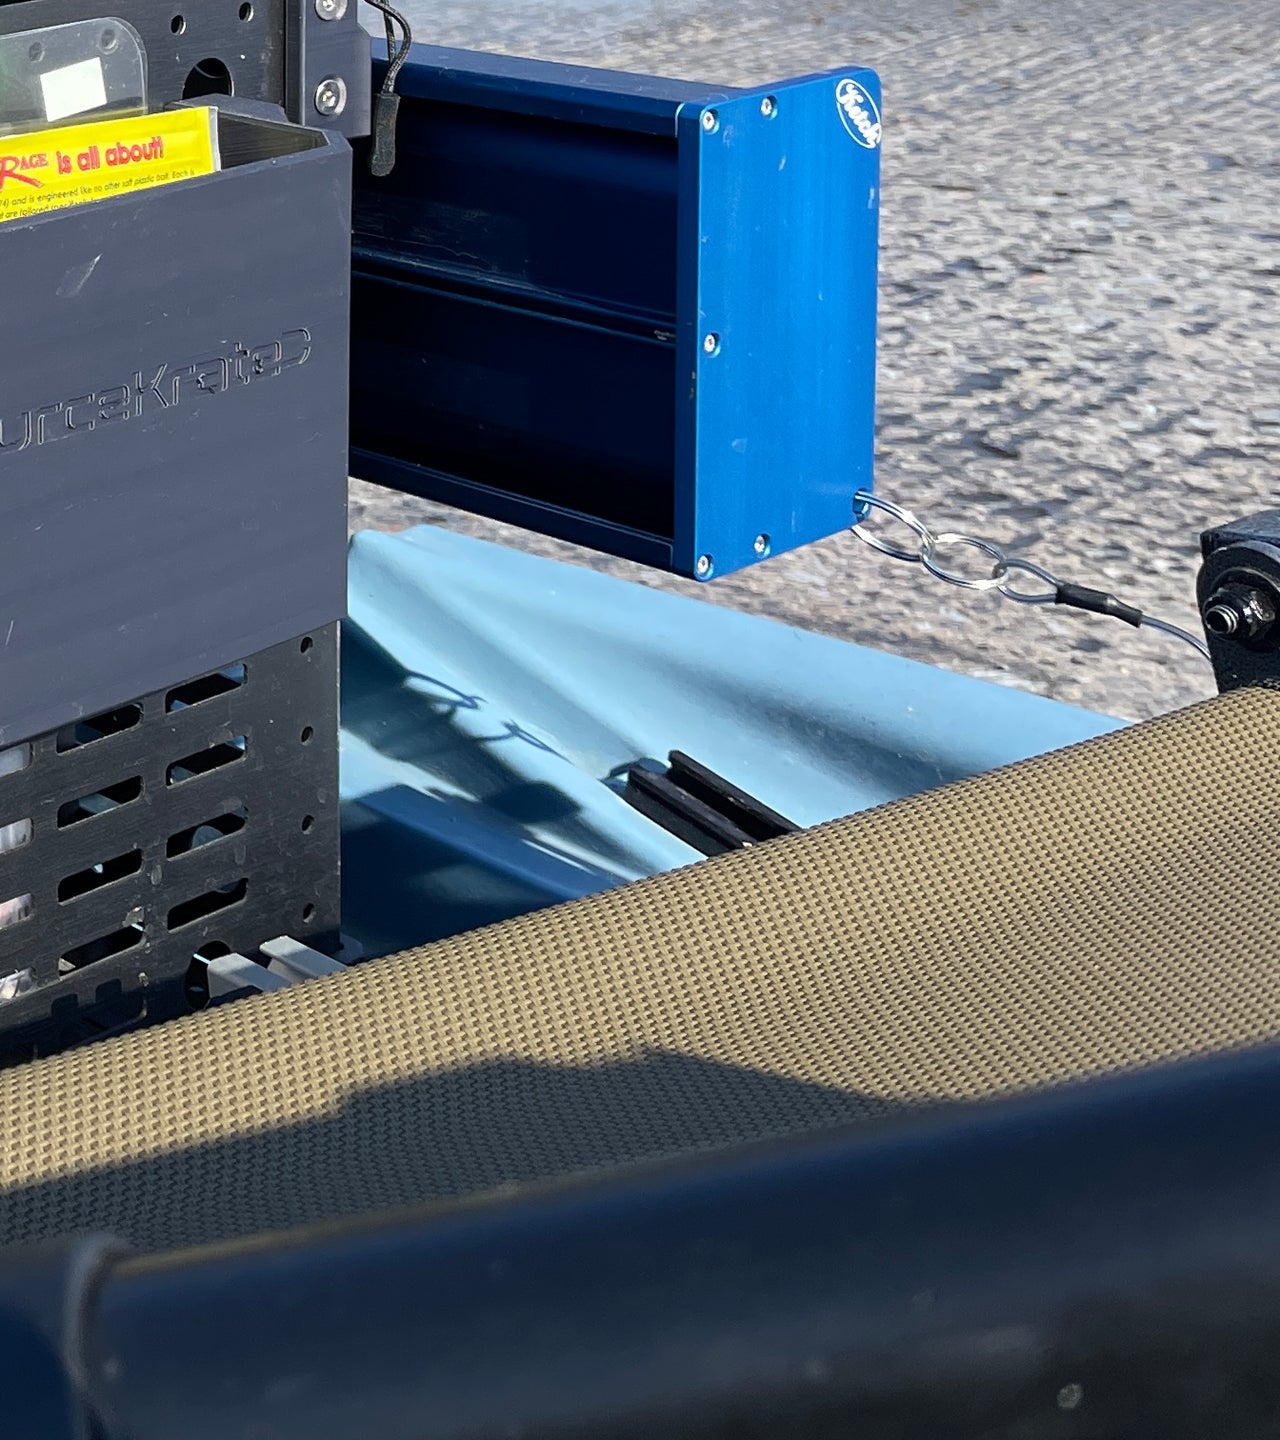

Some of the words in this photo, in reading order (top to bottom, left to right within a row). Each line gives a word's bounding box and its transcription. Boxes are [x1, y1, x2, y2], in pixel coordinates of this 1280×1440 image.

[56, 151, 72, 175] is
[77, 146, 101, 171] all
[105, 135, 164, 167] about!
[12, 196, 27, 206] and
[37, 188, 78, 203] engineered
[80, 184, 92, 195] like
